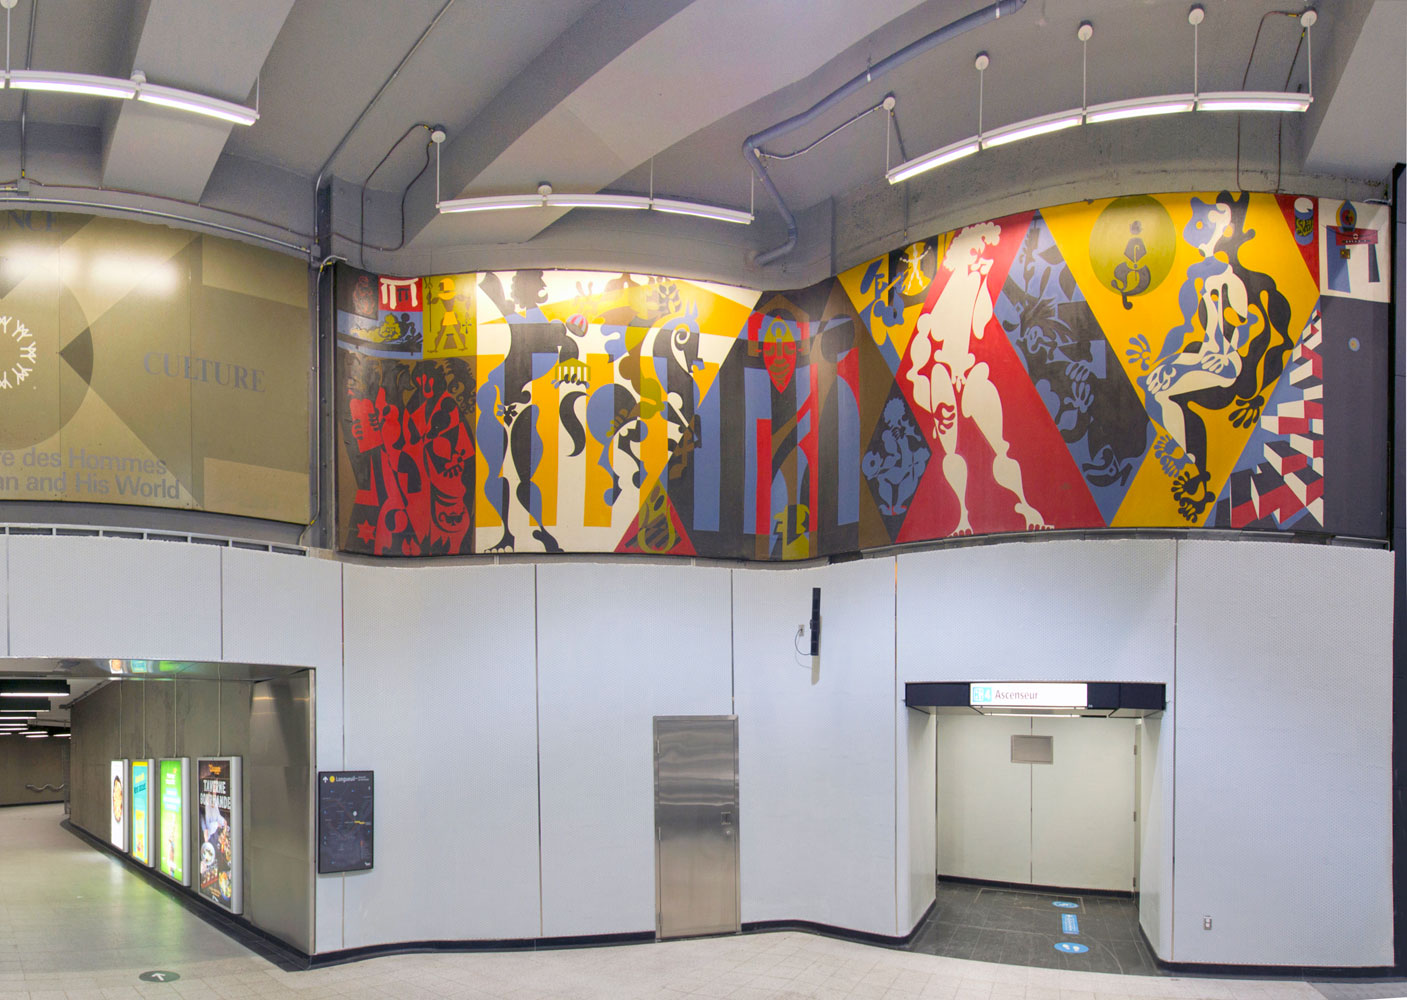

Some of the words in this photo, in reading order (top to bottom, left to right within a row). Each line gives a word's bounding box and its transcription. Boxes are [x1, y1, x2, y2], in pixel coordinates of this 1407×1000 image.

[143, 351, 266, 393] CULTURE
[23, 447, 61, 468] des
[69, 448, 167, 475] Hommes
[26, 472, 66, 493] and
[75, 472, 110, 495] His
[115, 475, 180, 499] World
[995, 690, 1038, 700] Ascenseur
